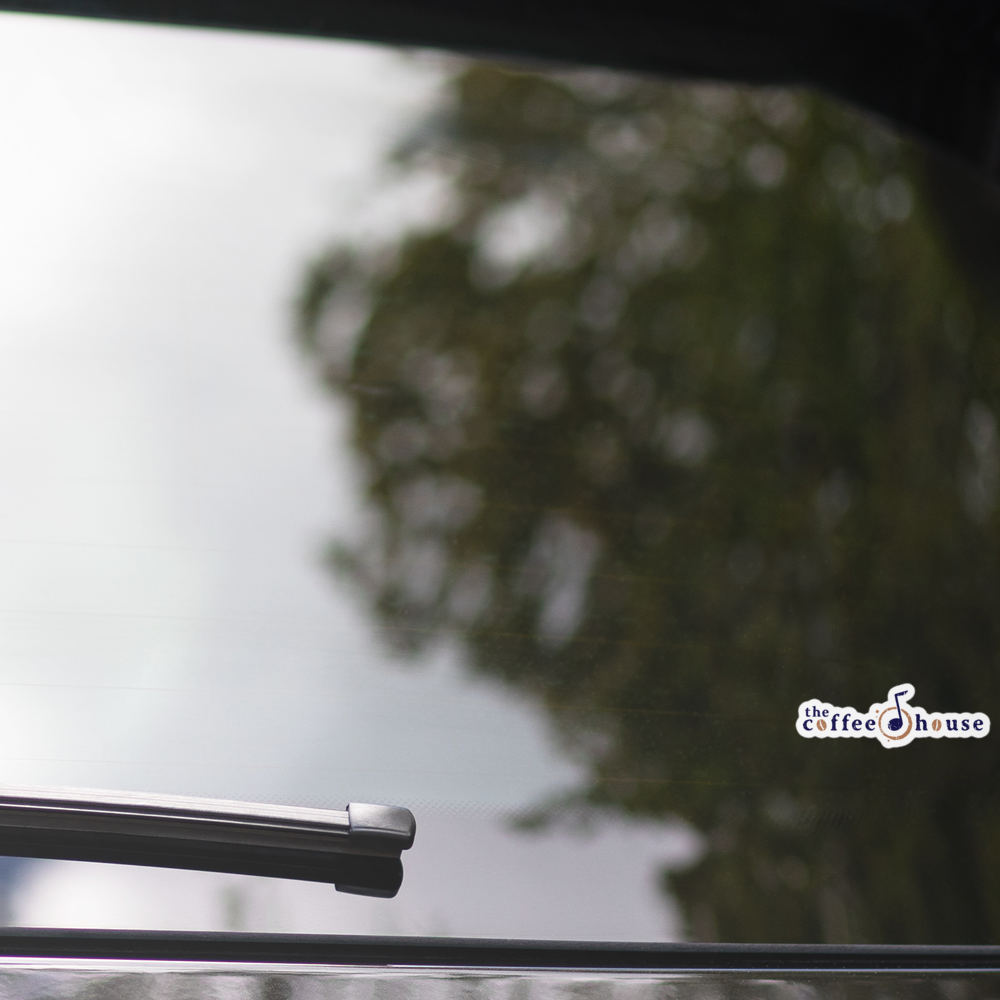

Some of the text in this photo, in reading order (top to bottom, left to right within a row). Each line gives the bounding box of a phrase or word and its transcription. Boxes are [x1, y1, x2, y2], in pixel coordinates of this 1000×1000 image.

[805, 706, 829, 717] the
[803, 714, 984, 731] coffee house
